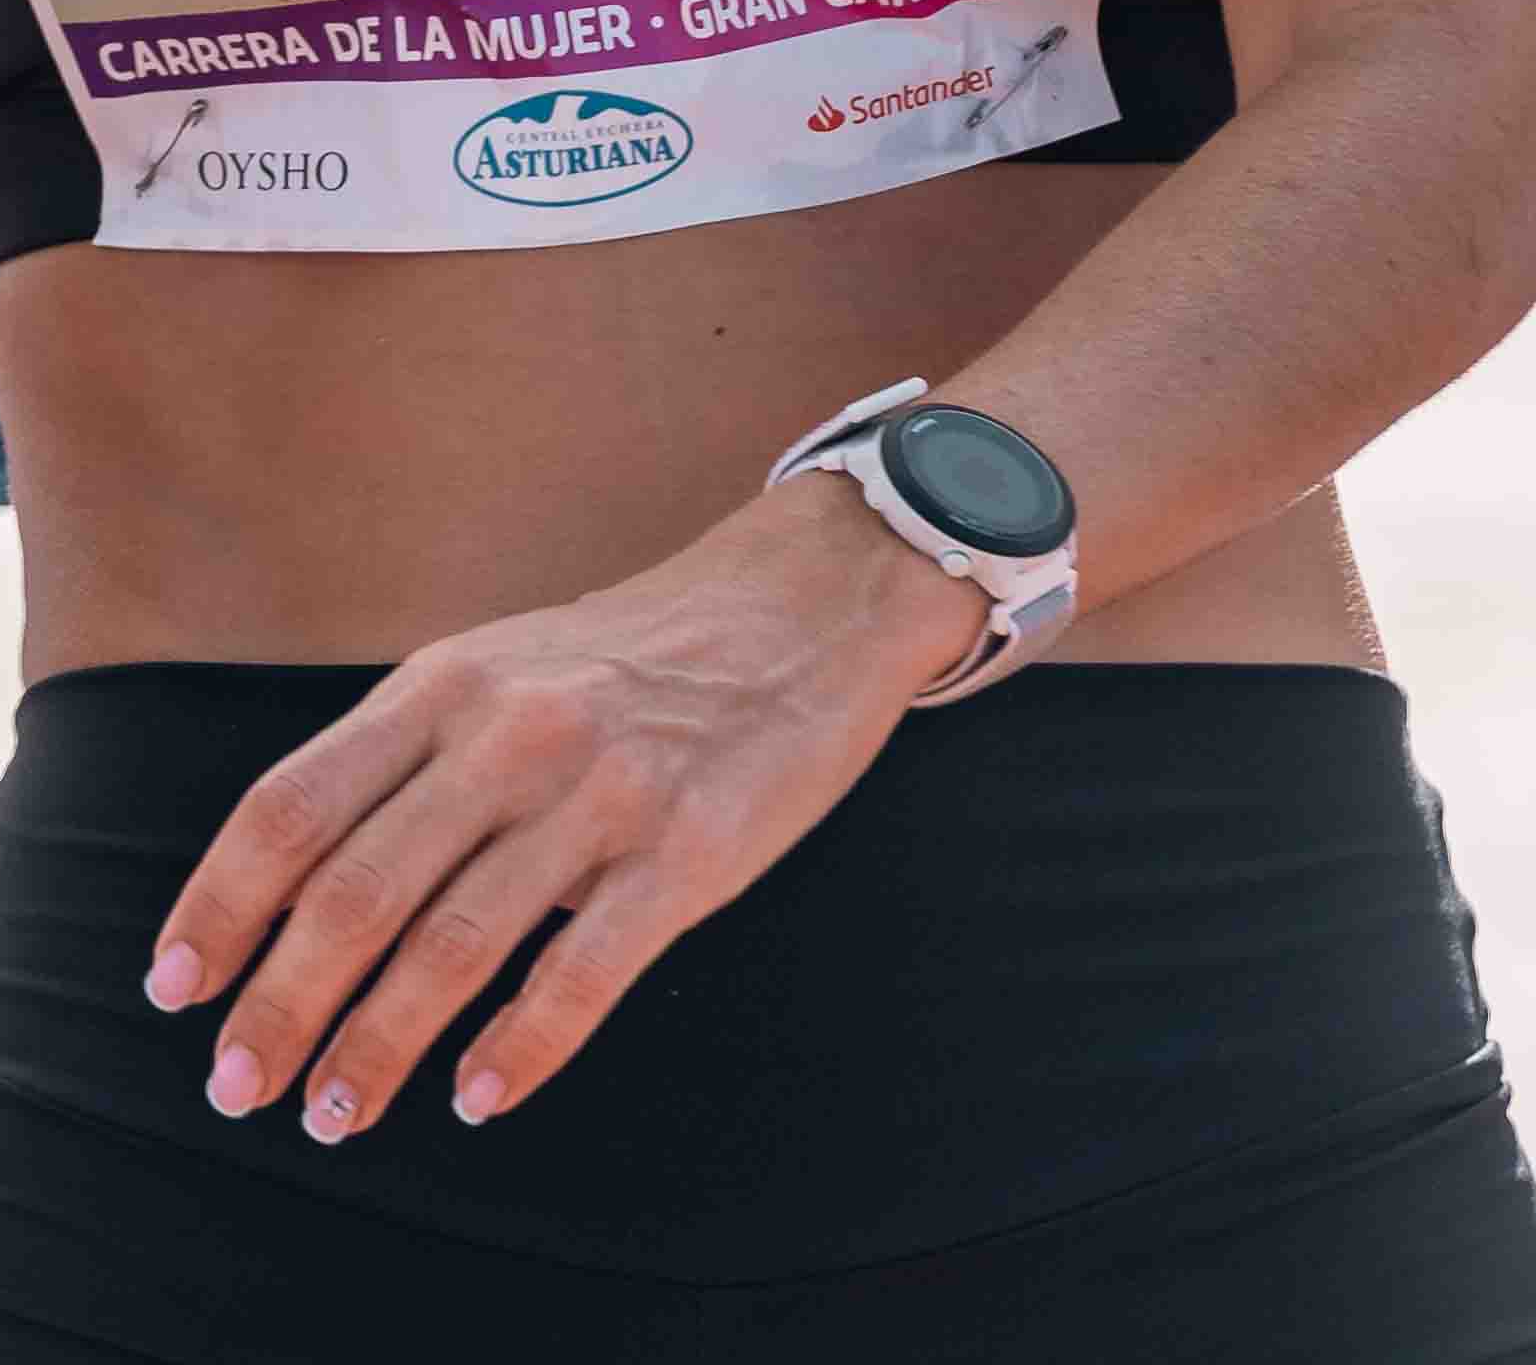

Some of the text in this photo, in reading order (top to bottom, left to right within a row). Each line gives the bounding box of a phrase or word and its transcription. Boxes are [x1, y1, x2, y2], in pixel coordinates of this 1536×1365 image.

[97, 26, 318, 82] CARRERA
[324, 15, 382, 63] DE
[394, 15, 457, 62] LA
[464, 4, 636, 62] MUJER
[850, 65, 995, 125] Santander
[196, 150, 350, 192] OYSHO
[471, 133, 678, 180] ASTURIANA
